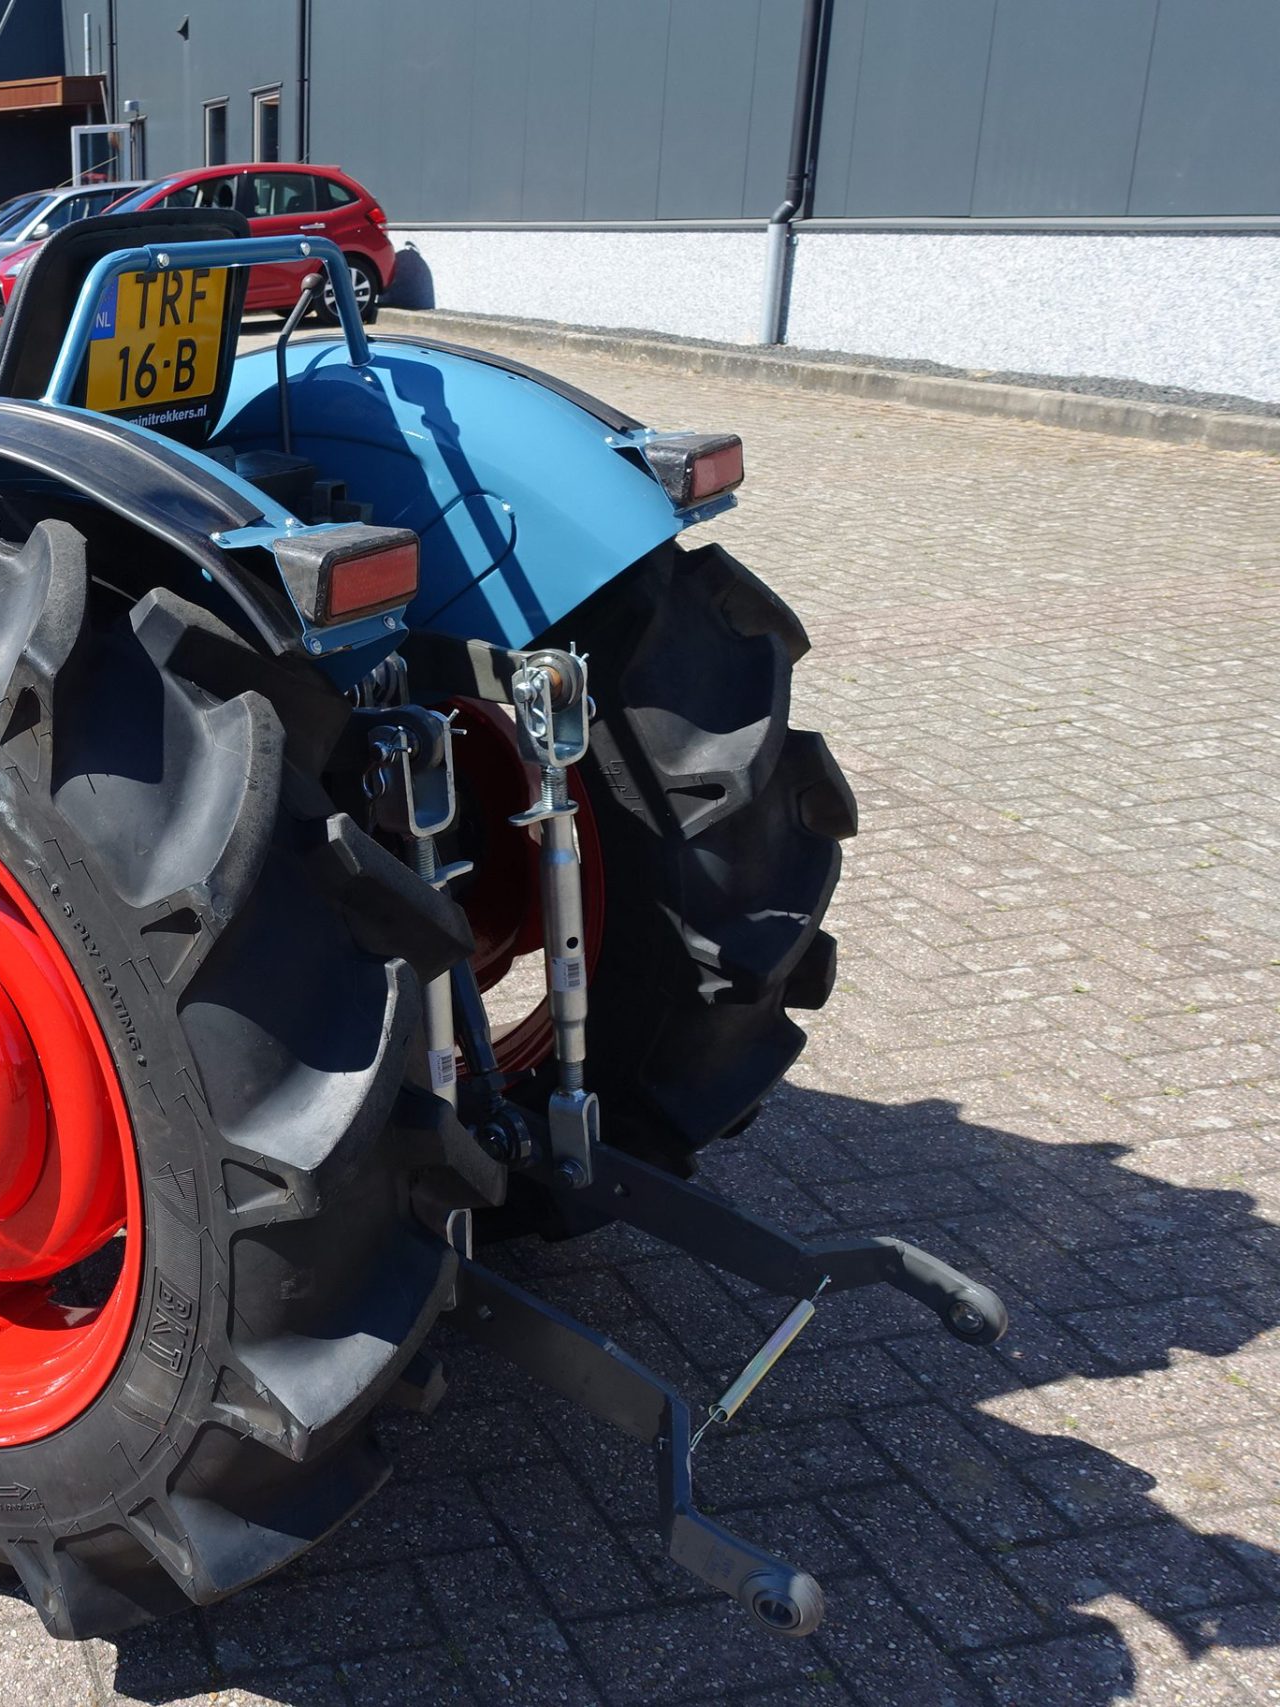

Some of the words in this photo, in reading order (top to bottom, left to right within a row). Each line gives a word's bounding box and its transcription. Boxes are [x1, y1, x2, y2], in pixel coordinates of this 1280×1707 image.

[95, 311, 111, 329] NL
[135, 268, 211, 330] TRF
[119, 338, 198, 402] 16-B
[72, 918, 101, 959] PLY
[96, 963, 143, 1053] RATING
[147, 1276, 193, 1374] BKT
